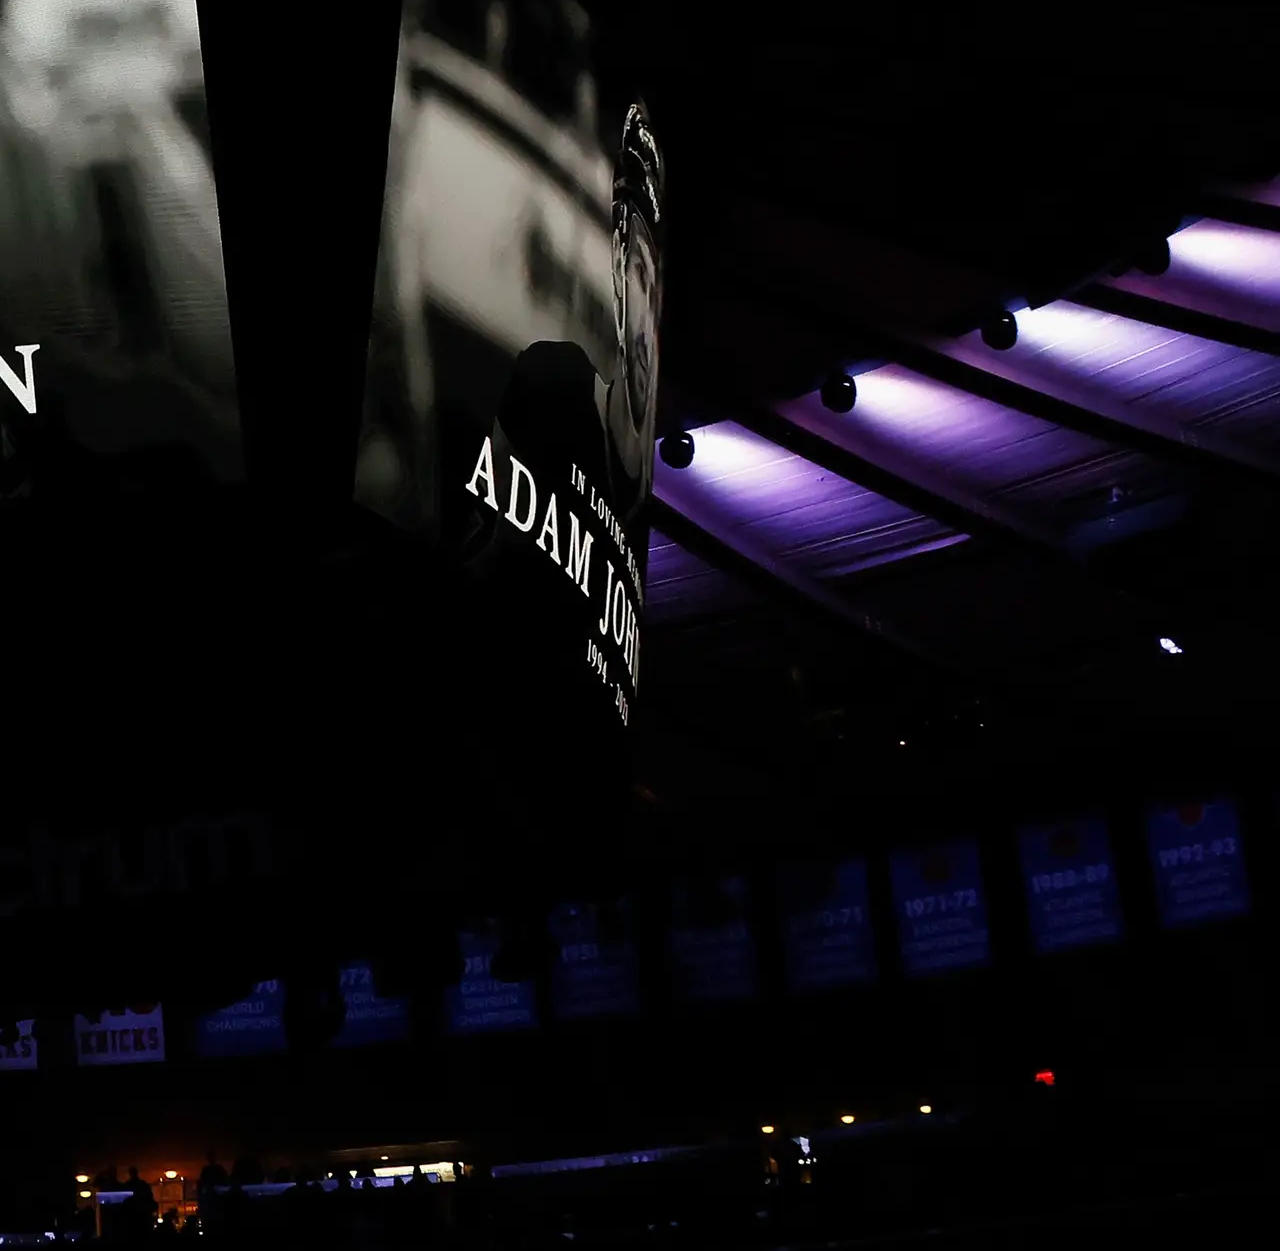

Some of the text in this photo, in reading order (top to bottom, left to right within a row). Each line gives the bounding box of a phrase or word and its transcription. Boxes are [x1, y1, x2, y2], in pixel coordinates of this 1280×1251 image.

[465, 436, 594, 598] ADAM
[571, 463, 627, 555] IN LOVING
[586, 639, 608, 684] 1994
[904, 888, 978, 918] 1971-72
[80, 1027, 159, 1054] KNICKS
